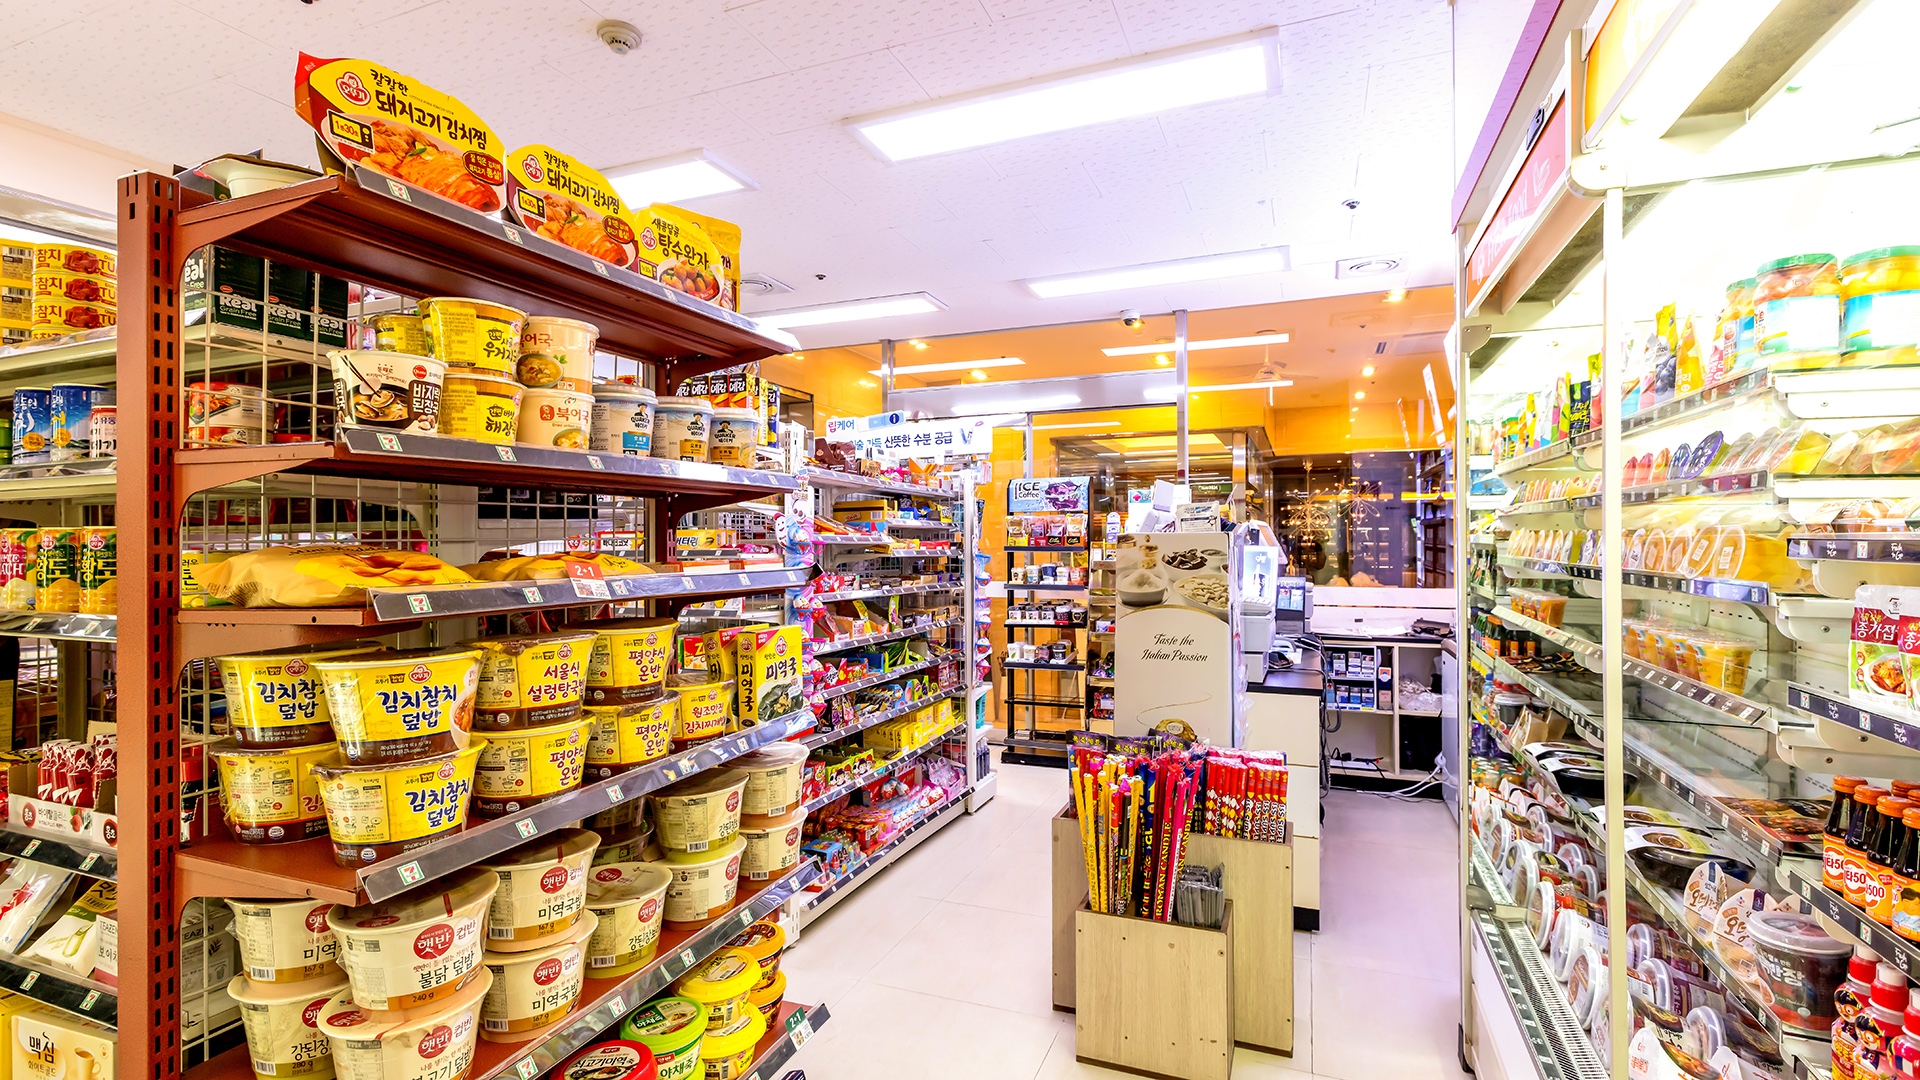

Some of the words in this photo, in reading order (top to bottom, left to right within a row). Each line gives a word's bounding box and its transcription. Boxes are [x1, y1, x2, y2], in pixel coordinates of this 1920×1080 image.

[370, 68, 409, 97] 칼칼한
[342, 84, 367, 101] 오뚜기
[543, 151, 569, 173] 칼칼한
[658, 234, 710, 271] 탕수완자
[98, 258, 117, 274] TU
[38, 277, 63, 291] 참치
[99, 286, 117, 301] TU
[38, 305, 62, 319] 참치
[413, 382, 441, 401] 바지락
[691, 382, 709, 395] 예감
[710, 382, 728, 394] 예감
[729, 380, 746, 393] 예감
[412, 399, 439, 416] 된장국
[557, 407, 590, 425] 북어국
[630, 416, 651, 426] QUAKER
[686, 423, 706, 433] QUAKER
[828, 419, 855, 434] 립케어
[713, 432, 736, 442] QUAKER
[885, 434, 911, 449] 산뜻한
[914, 433, 932, 447] 수분
[934, 431, 953, 446] 공급
[1018, 491, 1040, 499] Coffee
[1019, 481, 1041, 492] ICE
[37, 557, 71, 581] 황도
[81, 557, 117, 582] 황도
[574, 565, 595, 578] 2+1
[1153, 632, 1179, 647] Taste
[1179, 633, 1195, 648] the
[628, 645, 666, 668] 평양식
[1140, 648, 1171, 662] Italian
[1171, 649, 1209, 663] Passion
[410, 672, 431, 682] 오뚜기
[543, 660, 580, 682] 서울식
[638, 663, 662, 683] 온반
[765, 656, 798, 680] 미역국
[527, 677, 585, 704] 설렁탕국밥
[740, 662, 755, 712] 미역국
[379, 684, 457, 714] 김치참치
[278, 702, 320, 720] 덮밥
[692, 702, 725, 719] 원조맛집
[402, 710, 441, 732] 덮밥
[635, 719, 670, 742] 평양식
[645, 737, 666, 757] 온반
[560, 764, 581, 787] 온반
[405, 776, 470, 813] 김치참치
[727, 797, 739, 809] 햇반
[303, 795, 325, 813] 김
[428, 804, 459, 828] 덮밥
[1180, 808, 1195, 857] CANDLE
[1160, 822, 1173, 871] CANDLE
[542, 874, 569, 892] 햇반
[1866, 884, 1885, 899] 500
[1156, 876, 1168, 917] ROMAN
[538, 893, 583, 920] 미역국밥
[639, 904, 657, 920] 햇반
[99, 920, 118, 935] TEAZE
[309, 914, 328, 929] 햇
[538, 923, 549, 931] 167
[183, 925, 215, 941] EAZEN
[456, 920, 478, 943] 컵반
[303, 941, 344, 962] 미역
[416, 932, 452, 957] 햇반
[419, 966, 450, 990] 불닭
[453, 951, 475, 977] 덮밥
[564, 953, 580, 971] 컵반
[535, 966, 561, 984] 햇반
[412, 994, 427, 1004] 240
[428, 992, 435, 1001] g
[532, 978, 580, 1012] 미역국밥
[304, 1011, 320, 1024] 햇
[532, 1014, 543, 1022] 167
[636, 1014, 664, 1029] 야채죽
[789, 1012, 802, 1028] 2+1
[454, 1016, 473, 1039] 컵반
[29, 1034, 56, 1064] 맥심
[291, 1036, 337, 1061] 강된장
[421, 1033, 452, 1055] 햇반
[292, 1061, 306, 1070] 280
[660, 1056, 694, 1080] 야채죽
